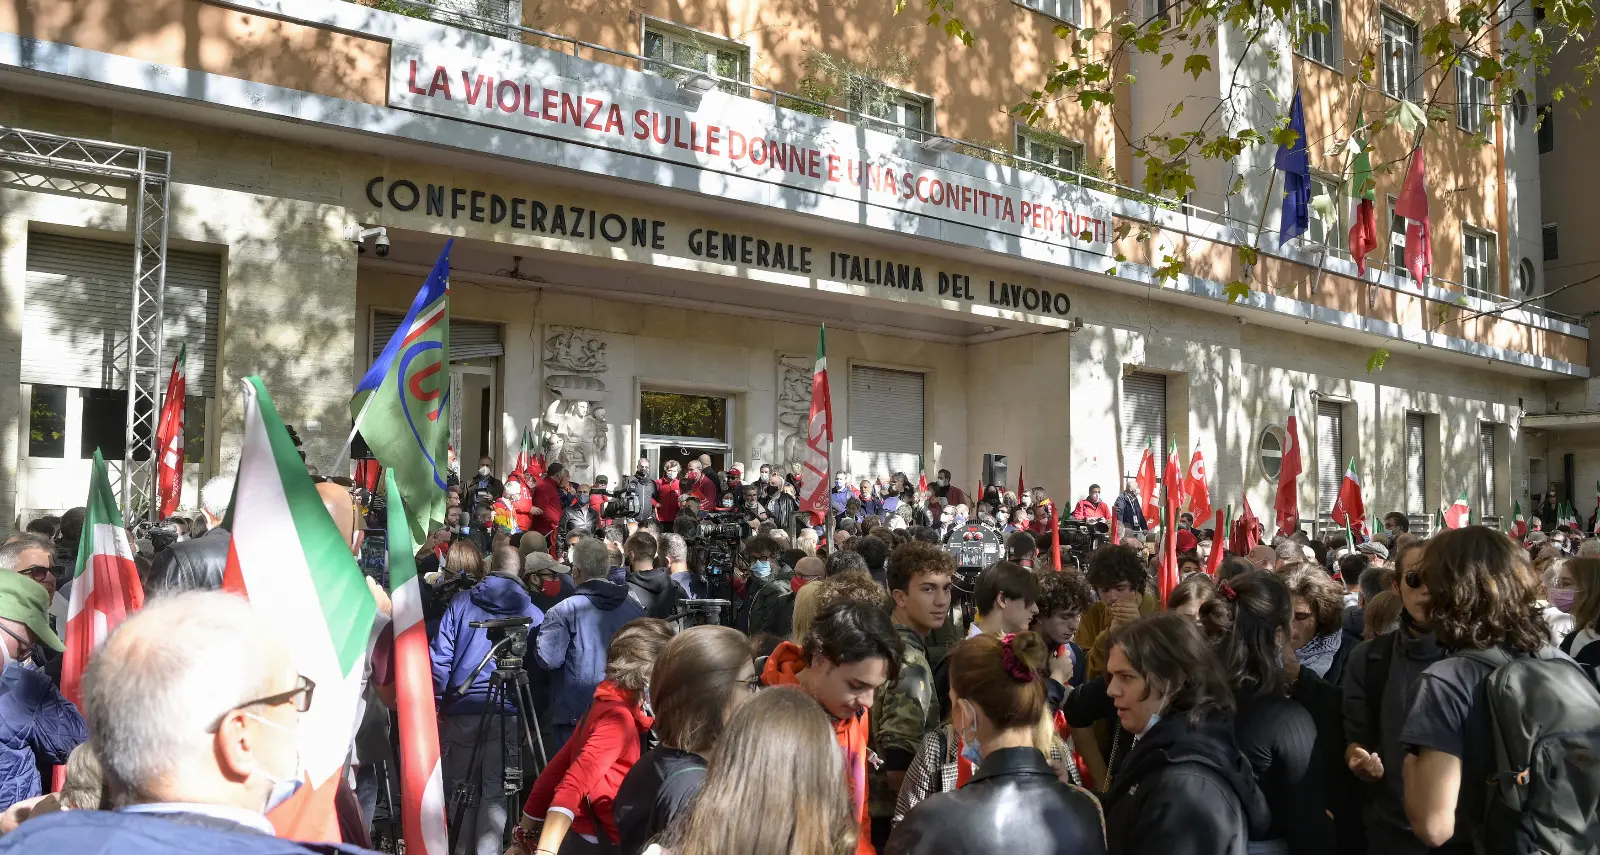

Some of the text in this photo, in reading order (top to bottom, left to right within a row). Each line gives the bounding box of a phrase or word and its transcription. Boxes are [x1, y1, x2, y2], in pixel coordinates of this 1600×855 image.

[408, 60, 452, 99] LA
[462, 72, 625, 137] VIOLENZA
[633, 110, 721, 157] SULLE
[727, 129, 821, 179] DONNE
[827, 146, 841, 183] È
[847, 157, 898, 196] UNA
[902, 171, 1015, 223] SCONFITTA
[1020, 201, 1054, 231] PER
[1055, 208, 1107, 243] TUTTI
[366, 176, 1073, 316] CONFEDERAZIONE GENERALE ITALIANA DEL LAVORO
